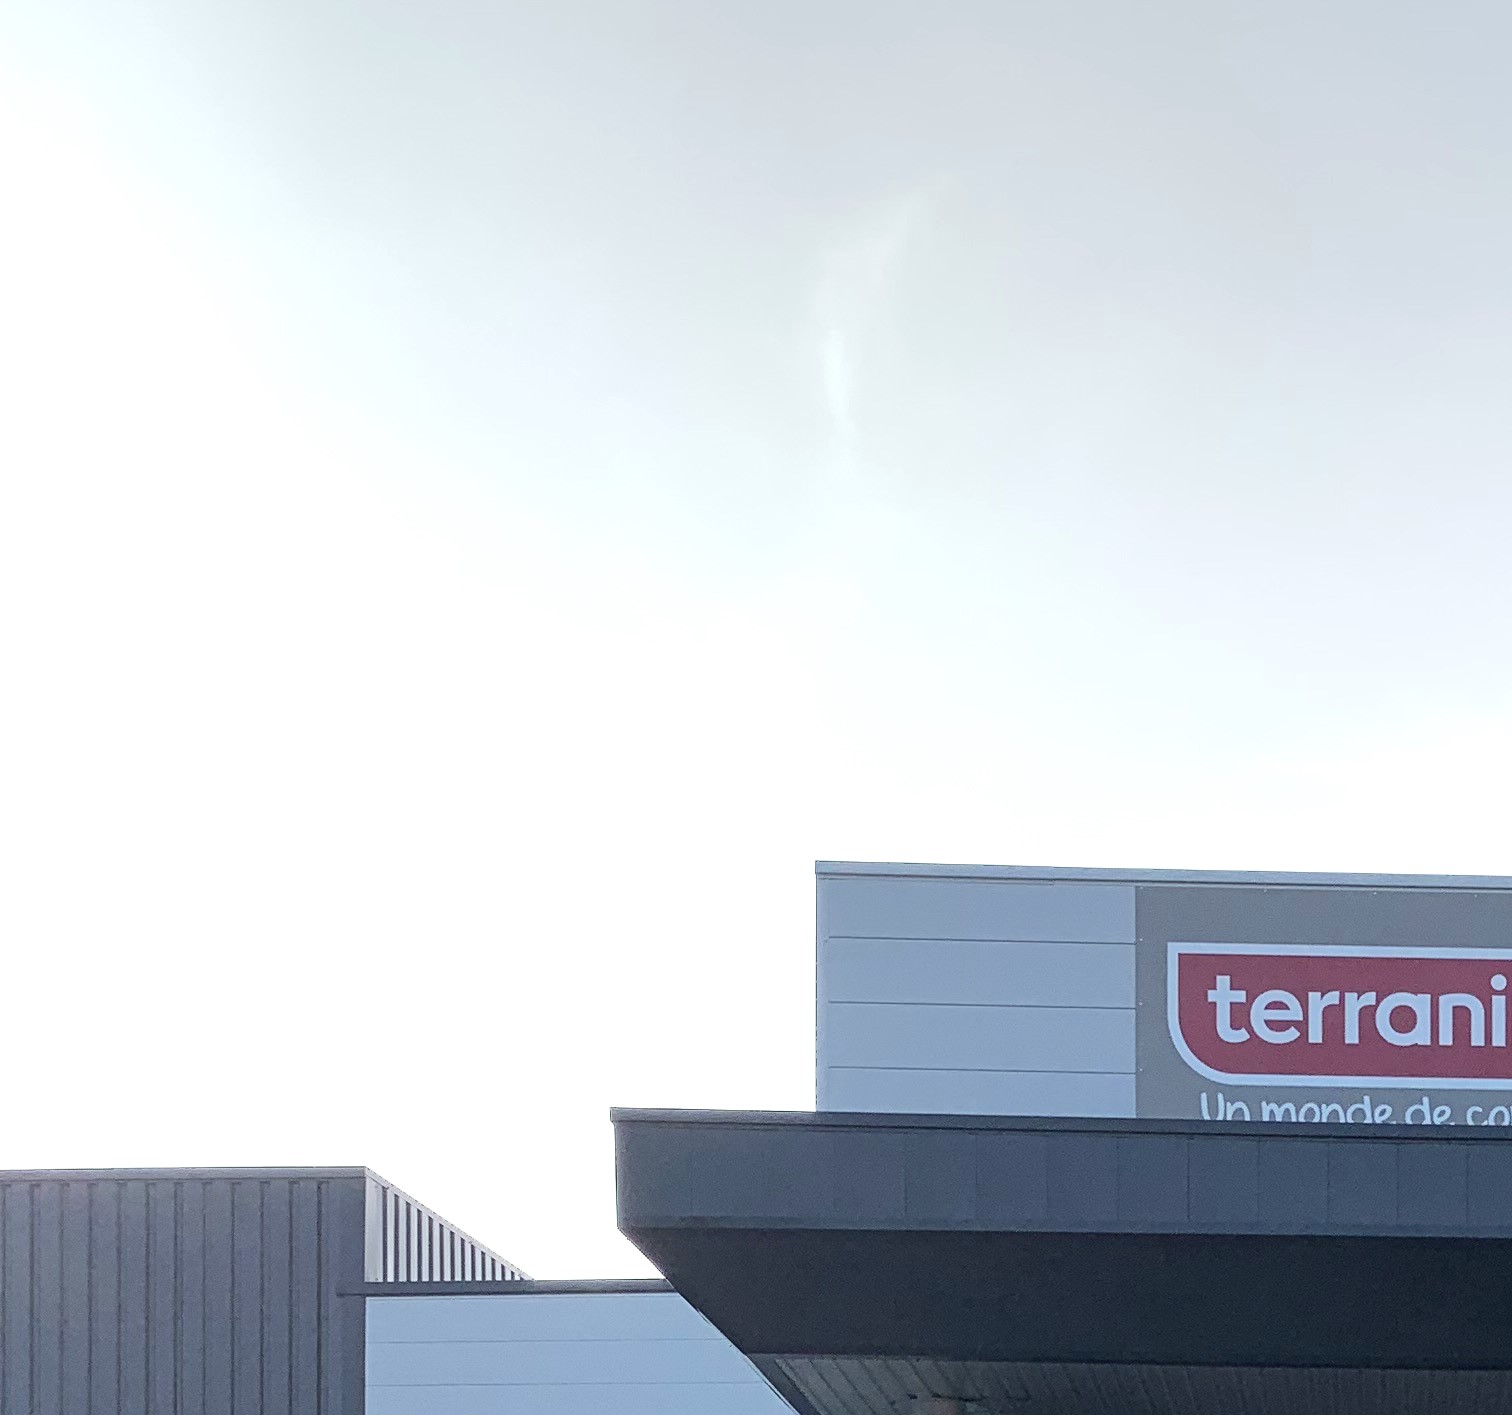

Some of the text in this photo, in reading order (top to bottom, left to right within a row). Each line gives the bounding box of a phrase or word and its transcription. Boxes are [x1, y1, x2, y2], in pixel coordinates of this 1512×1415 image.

[1200, 1092, 1251, 1121] Un
[1261, 1095, 1397, 1124] monde
[1404, 1096, 1455, 1126] de
